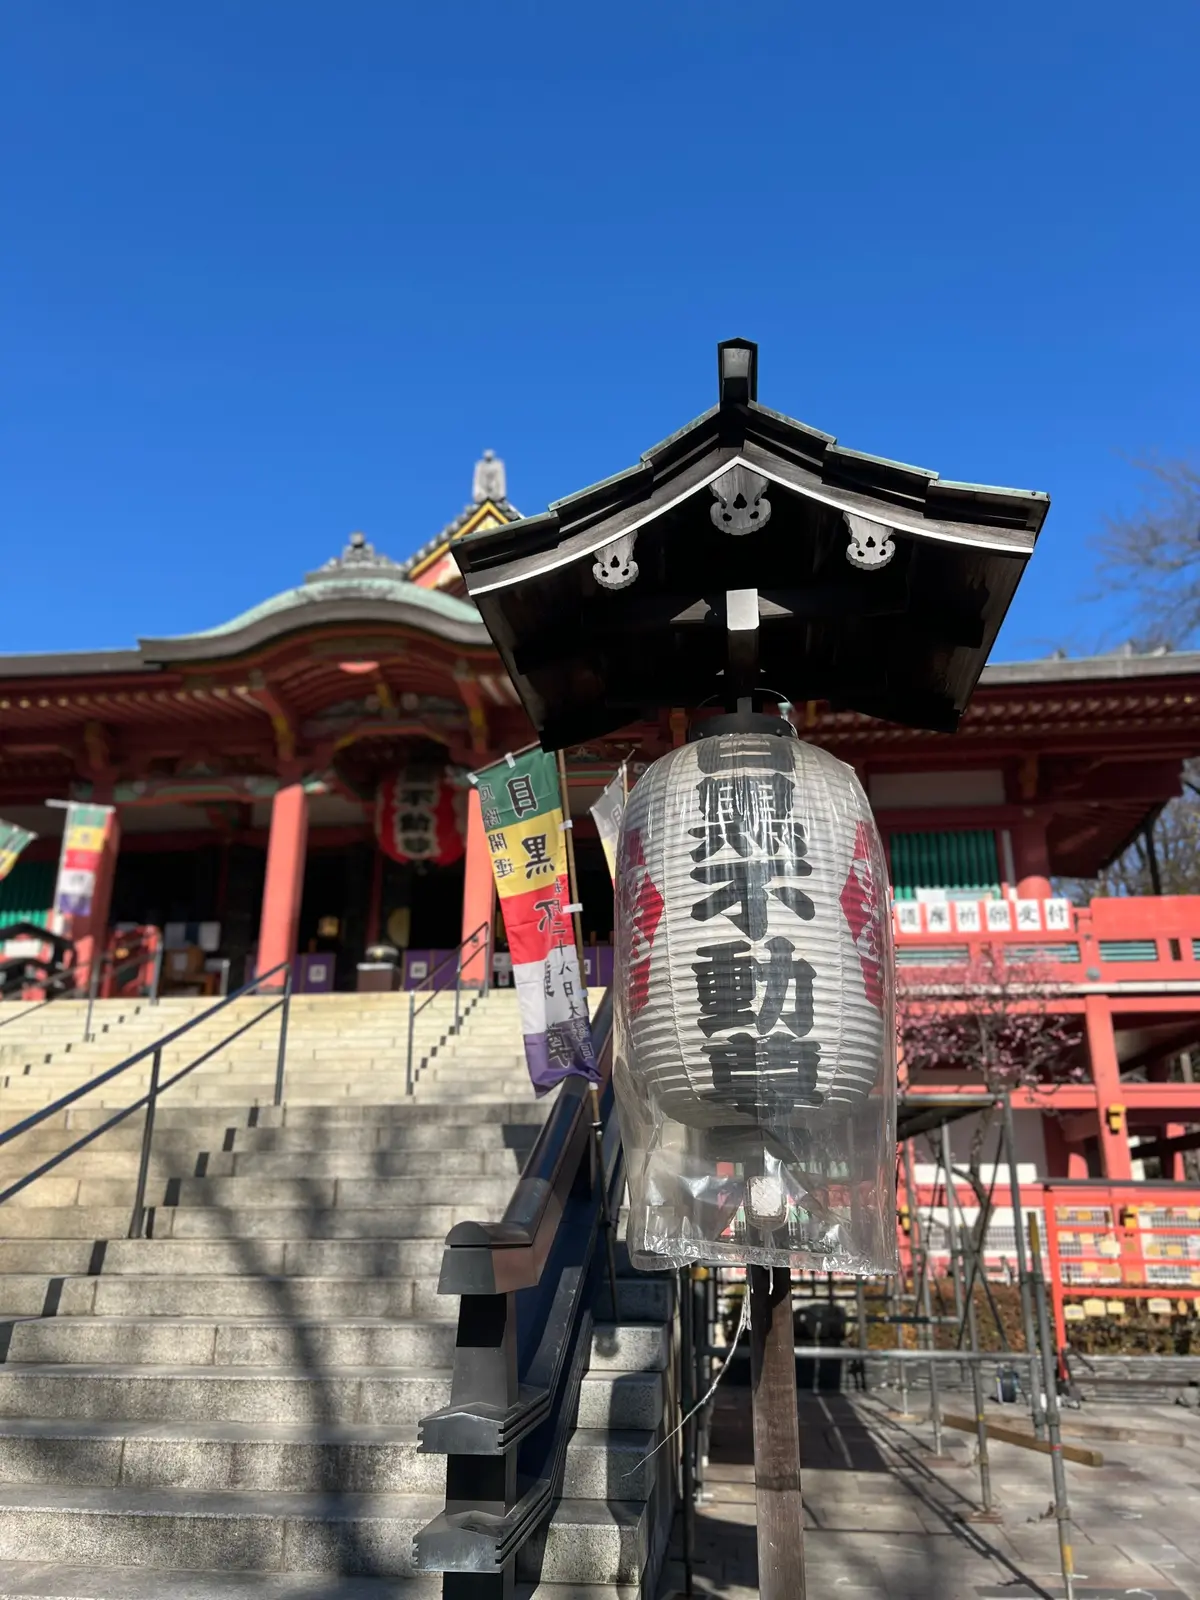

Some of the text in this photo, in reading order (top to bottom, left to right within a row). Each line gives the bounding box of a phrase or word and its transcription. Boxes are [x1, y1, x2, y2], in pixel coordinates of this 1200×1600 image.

[688, 733, 824, 1118] 目黒不動尊
